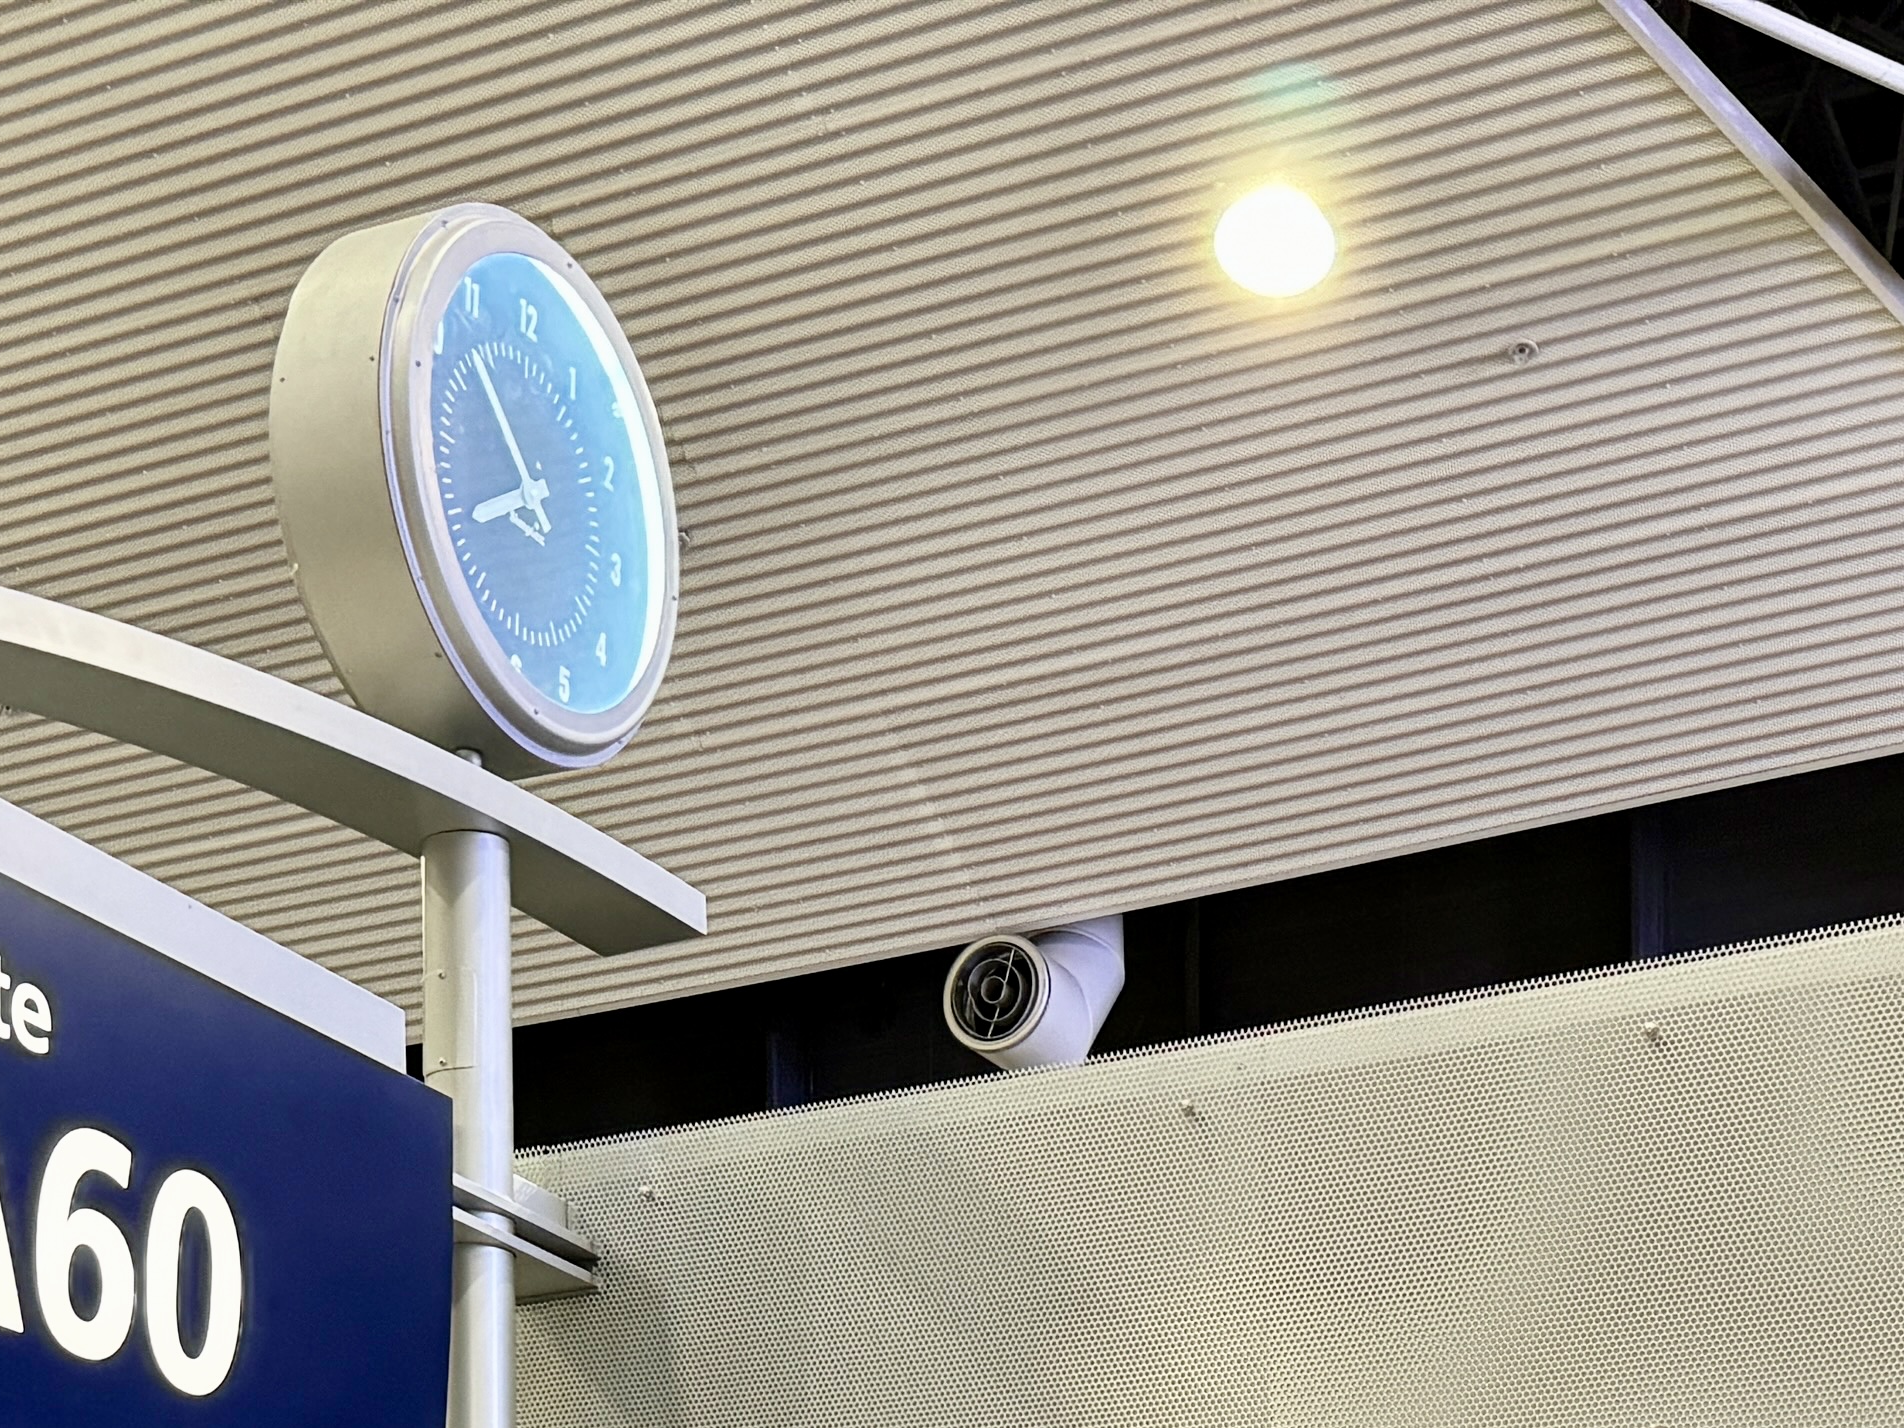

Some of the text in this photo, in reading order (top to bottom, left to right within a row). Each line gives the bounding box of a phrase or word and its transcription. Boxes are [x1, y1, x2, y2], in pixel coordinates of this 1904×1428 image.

[464, 276, 480, 319] 11
[520, 298, 538, 343] 12
[569, 366, 577, 400] 1
[604, 455, 615, 492] 2
[610, 553, 622, 588] 3
[595, 632, 607, 667] 4
[559, 665, 571, 704] 5
